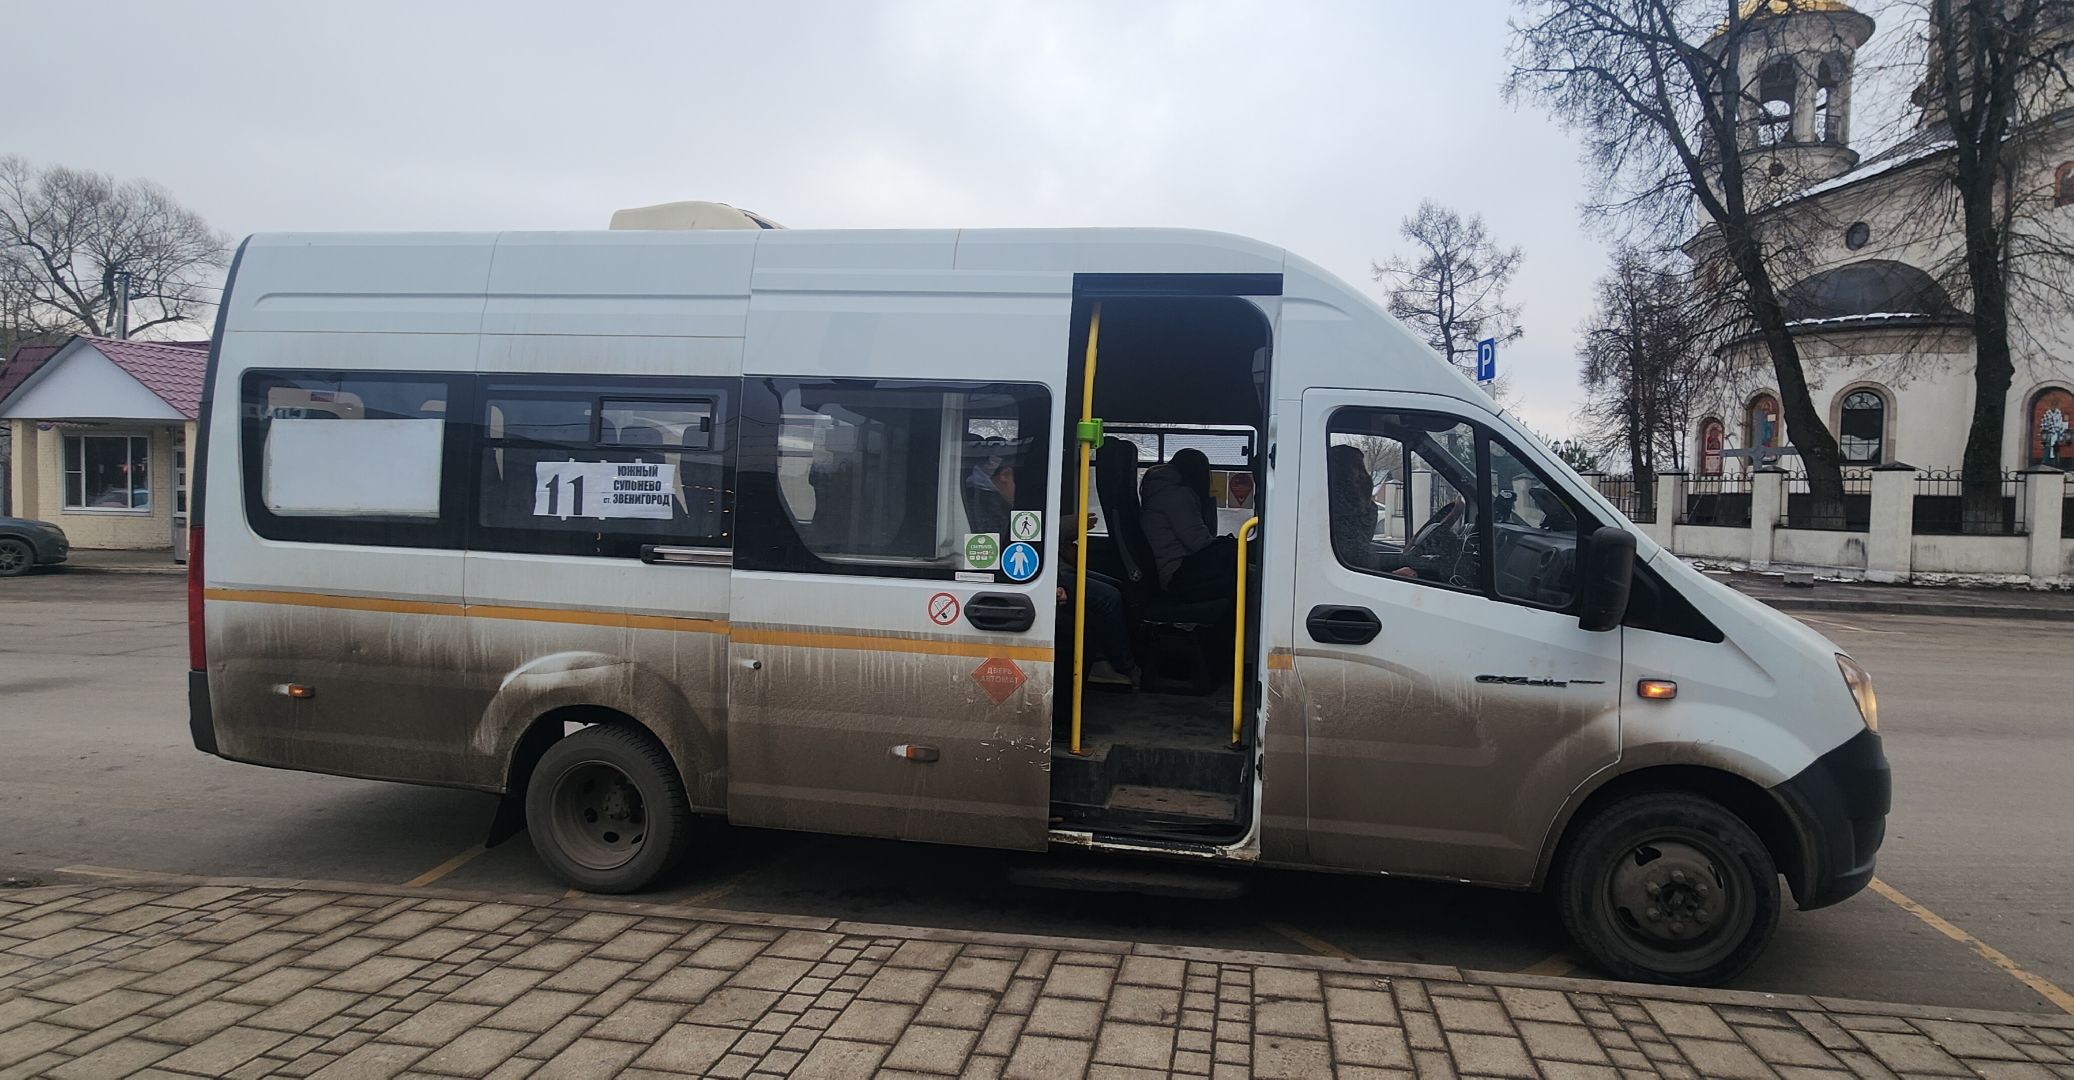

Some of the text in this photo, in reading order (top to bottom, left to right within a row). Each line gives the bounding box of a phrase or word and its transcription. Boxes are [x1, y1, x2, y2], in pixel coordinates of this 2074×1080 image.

[1482, 343, 1492, 377] P
[617, 465, 659, 477] ЮЖНЫЙ
[613, 480, 662, 492] СУПОНЕВО
[545, 473, 584, 516] 11
[612, 493, 671, 507] ЗВЕНИГОРОД
[986, 667, 1013, 675] ДВЕРЬ
